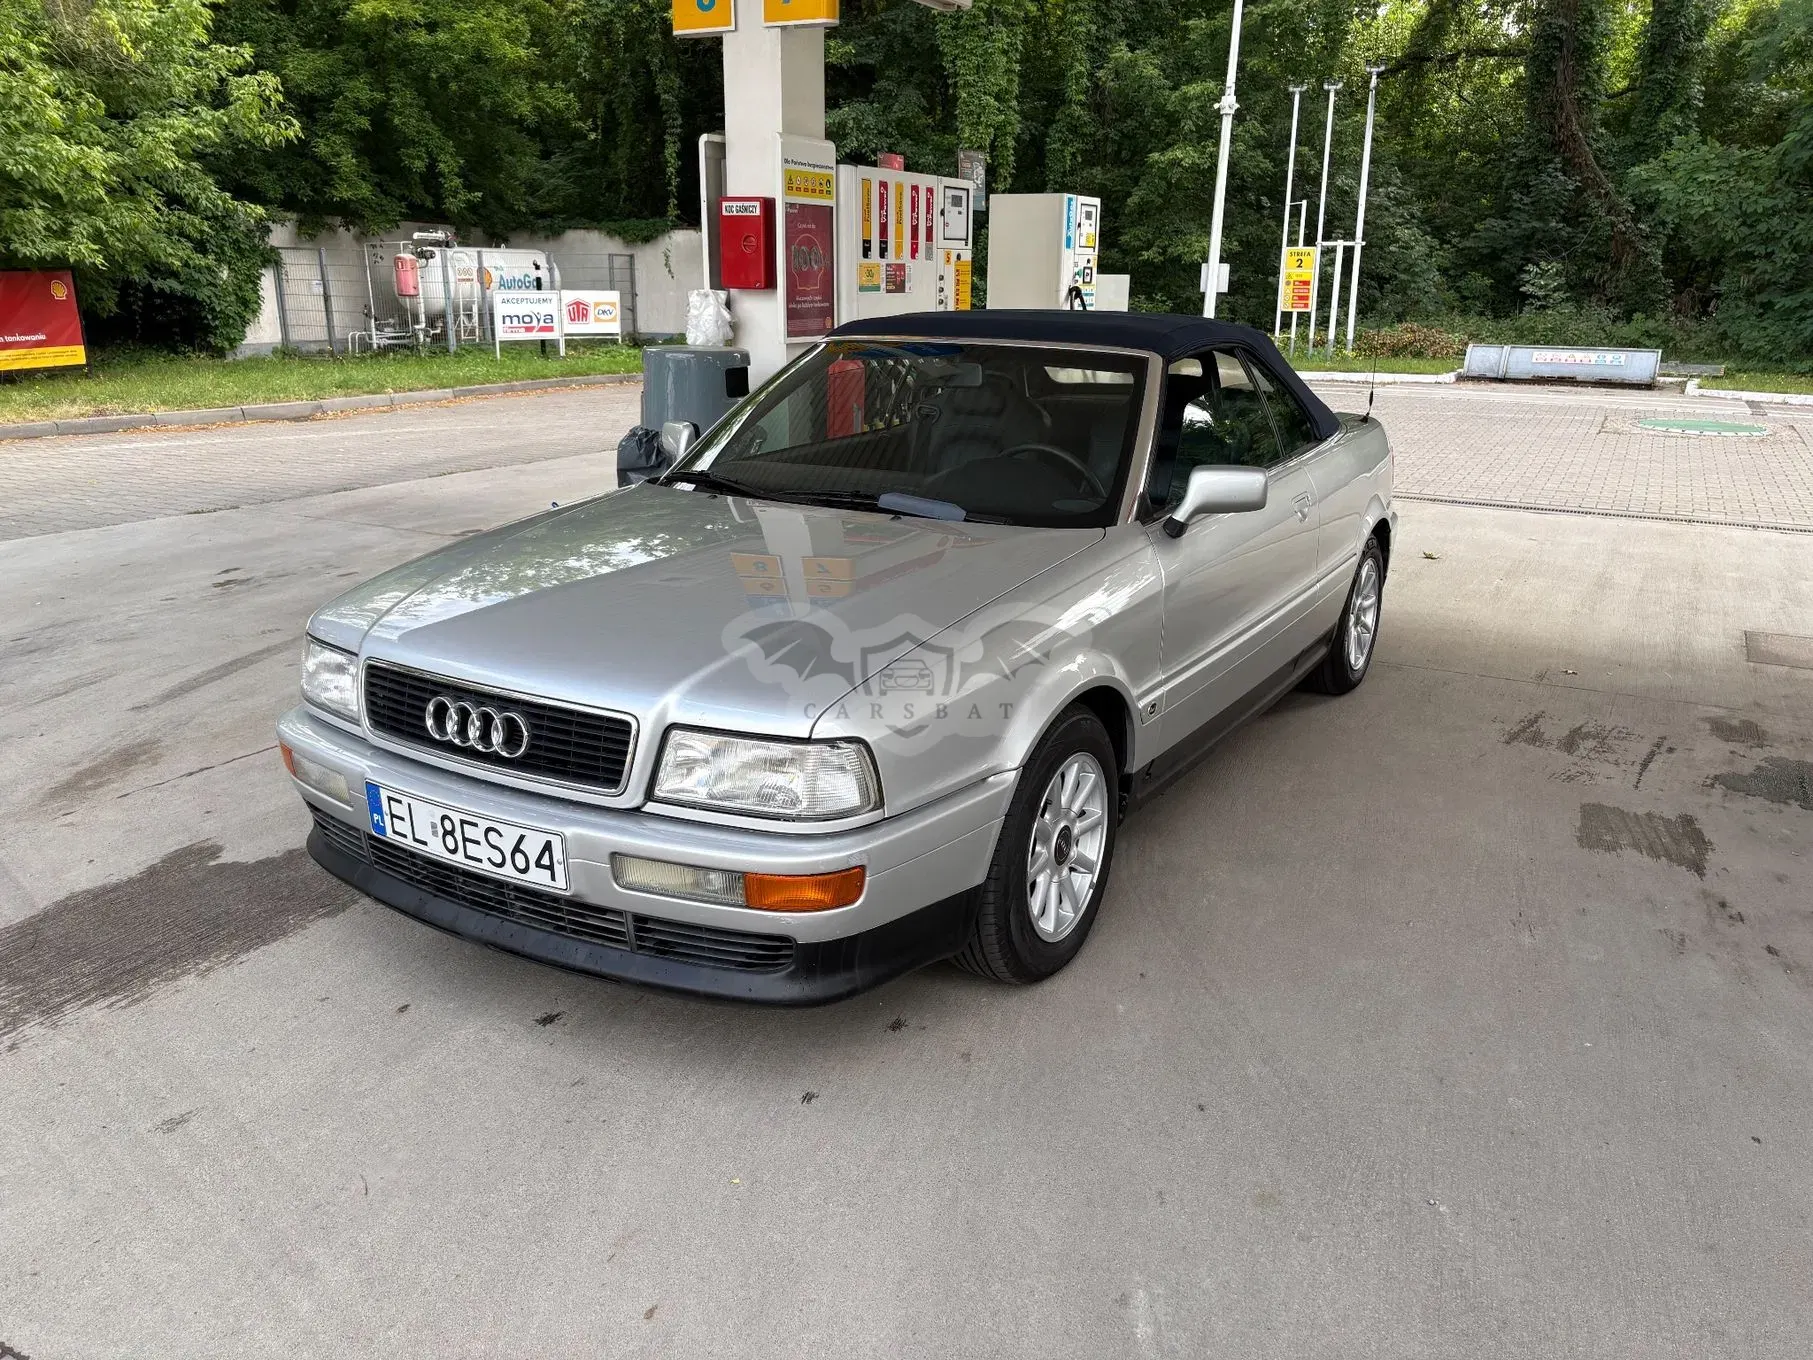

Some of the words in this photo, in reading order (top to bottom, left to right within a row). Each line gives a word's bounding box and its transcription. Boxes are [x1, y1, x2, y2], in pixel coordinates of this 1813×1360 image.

[724, 204, 735, 215] KOC
[1296, 258, 1303, 268] 2
[501, 297, 553, 305] AKCEPTUJEMY
[597, 308, 614, 316] DKV
[502, 311, 554, 326] moya
[4, 332, 46, 342] tankowaniu
[373, 813, 385, 827] PL
[386, 795, 428, 847] EL
[440, 814, 557, 882] 8ES64
